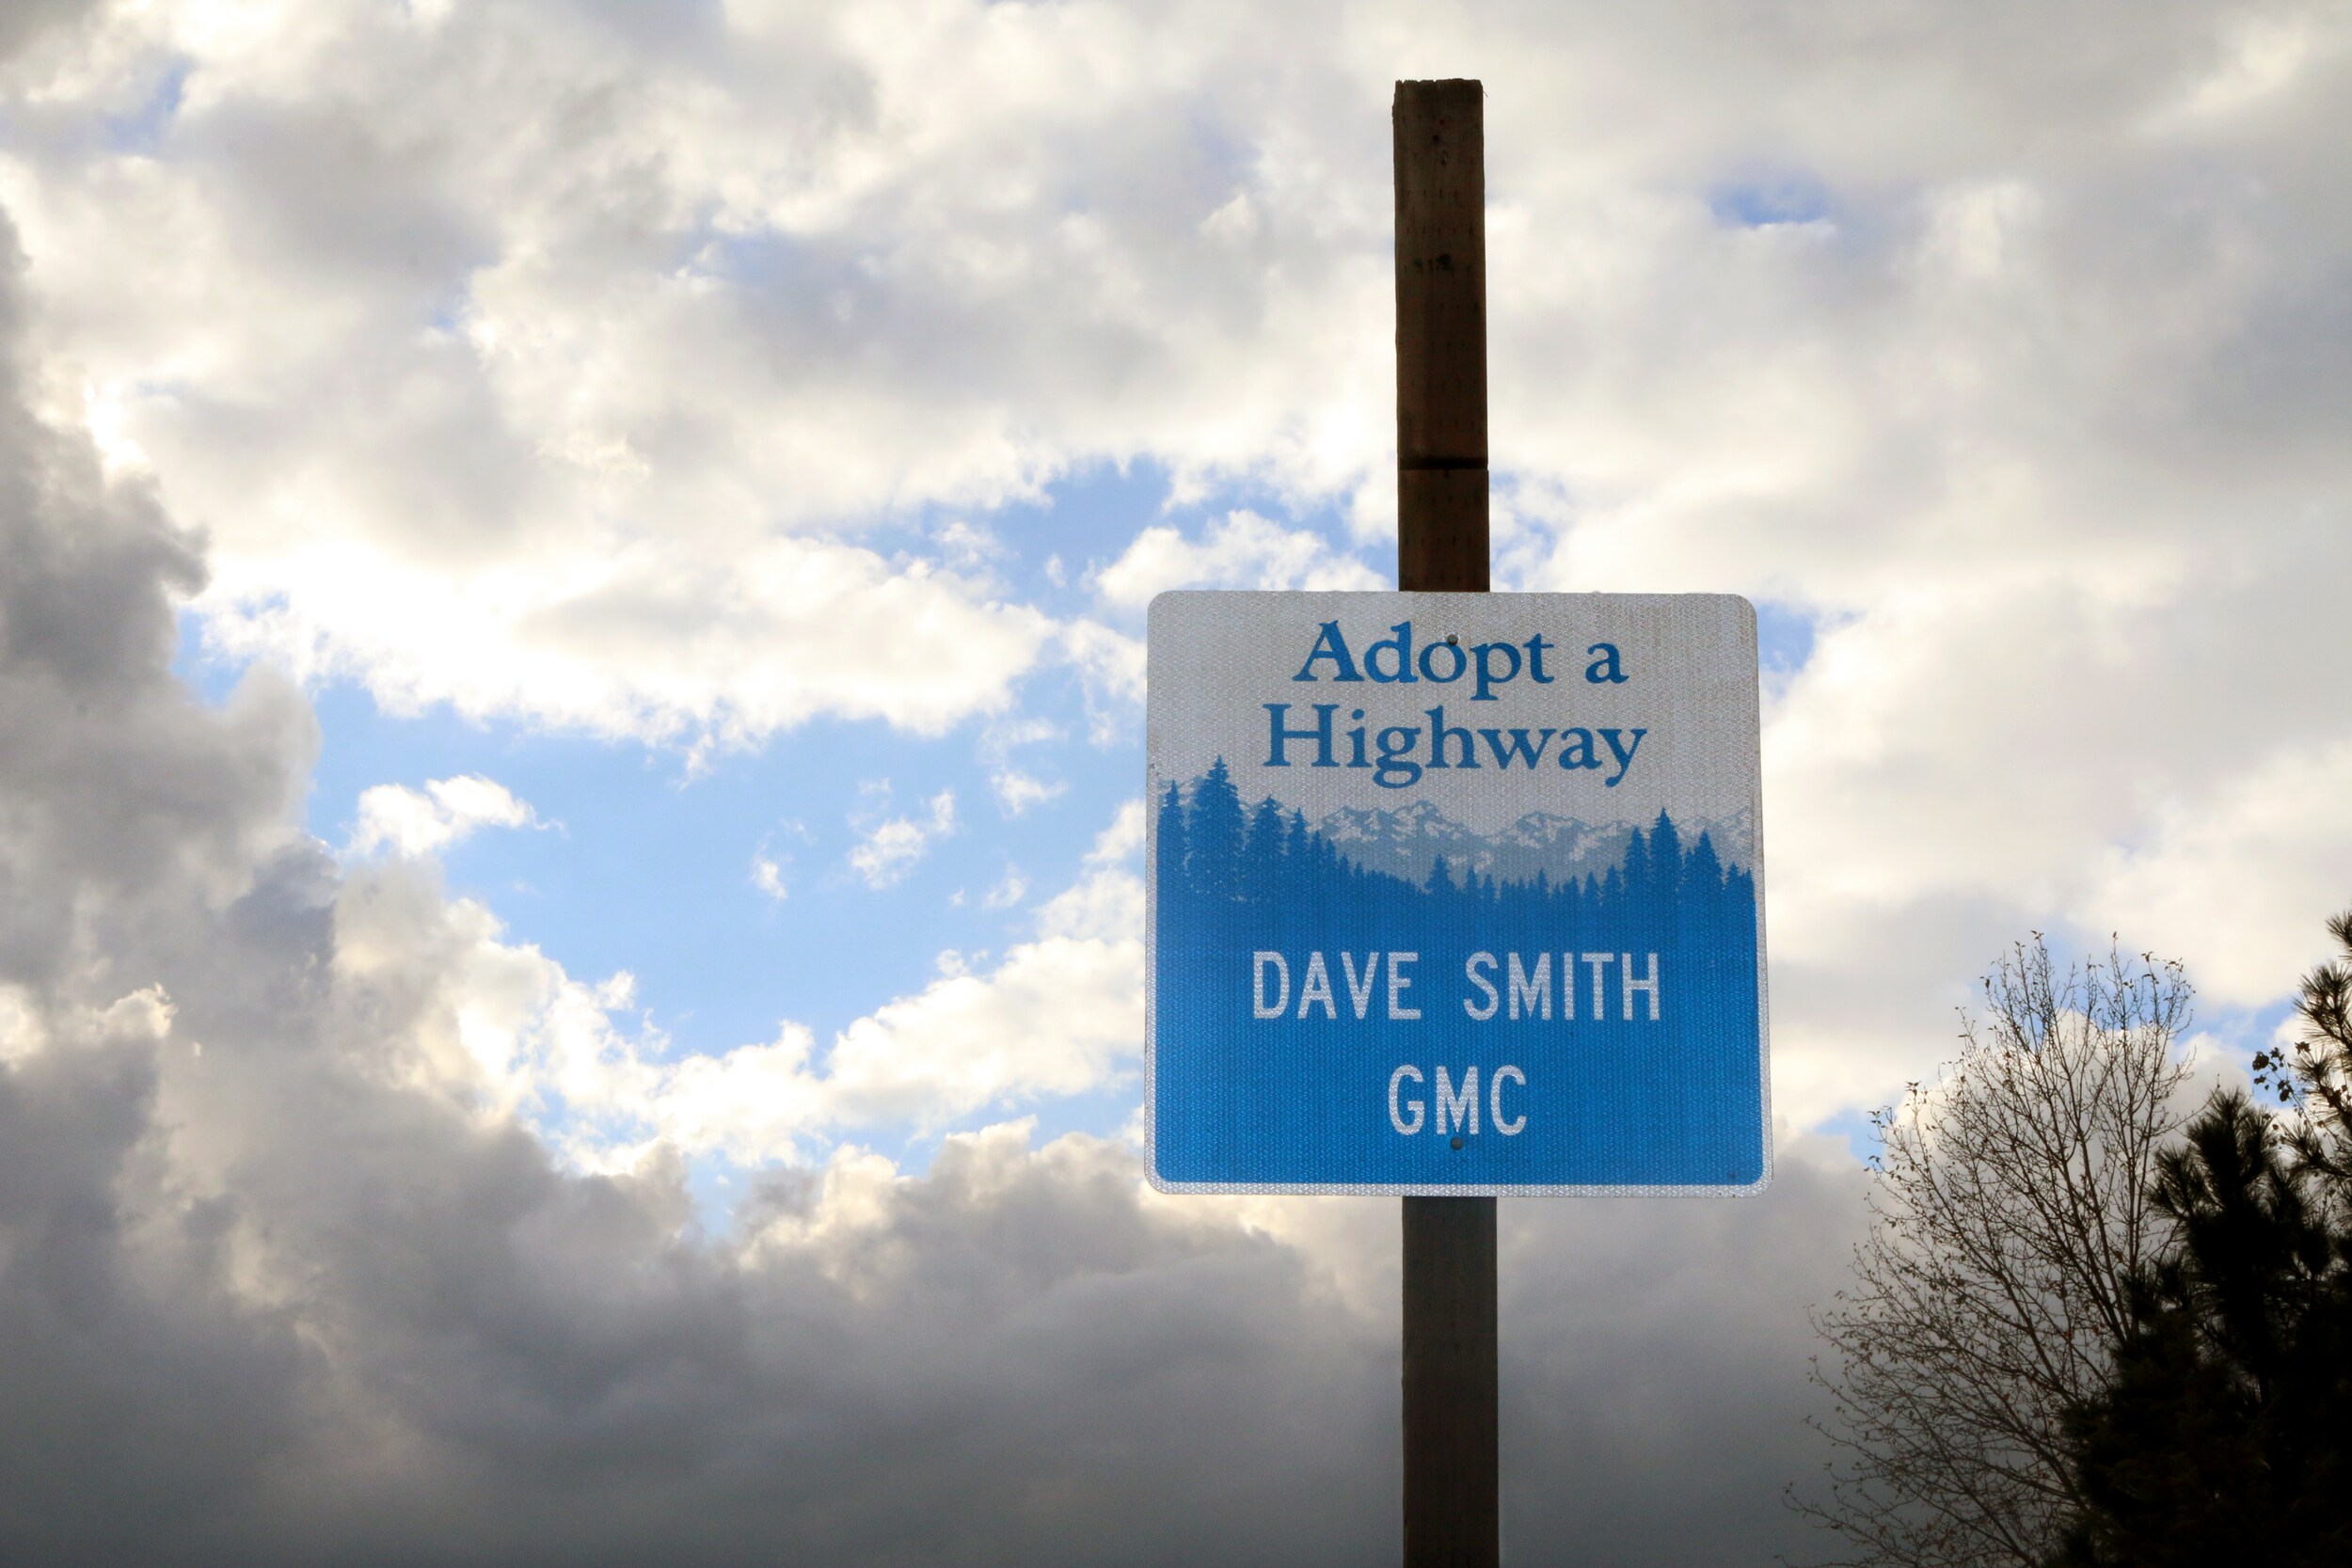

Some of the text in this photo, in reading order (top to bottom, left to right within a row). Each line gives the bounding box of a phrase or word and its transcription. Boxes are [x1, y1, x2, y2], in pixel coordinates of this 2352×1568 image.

[1292, 620, 1629, 701] Adopt a
[1262, 703, 1647, 789] Highway
[1252, 950, 1661, 1021] DAVE SMITH
[1388, 1064, 1528, 1135] GMC
